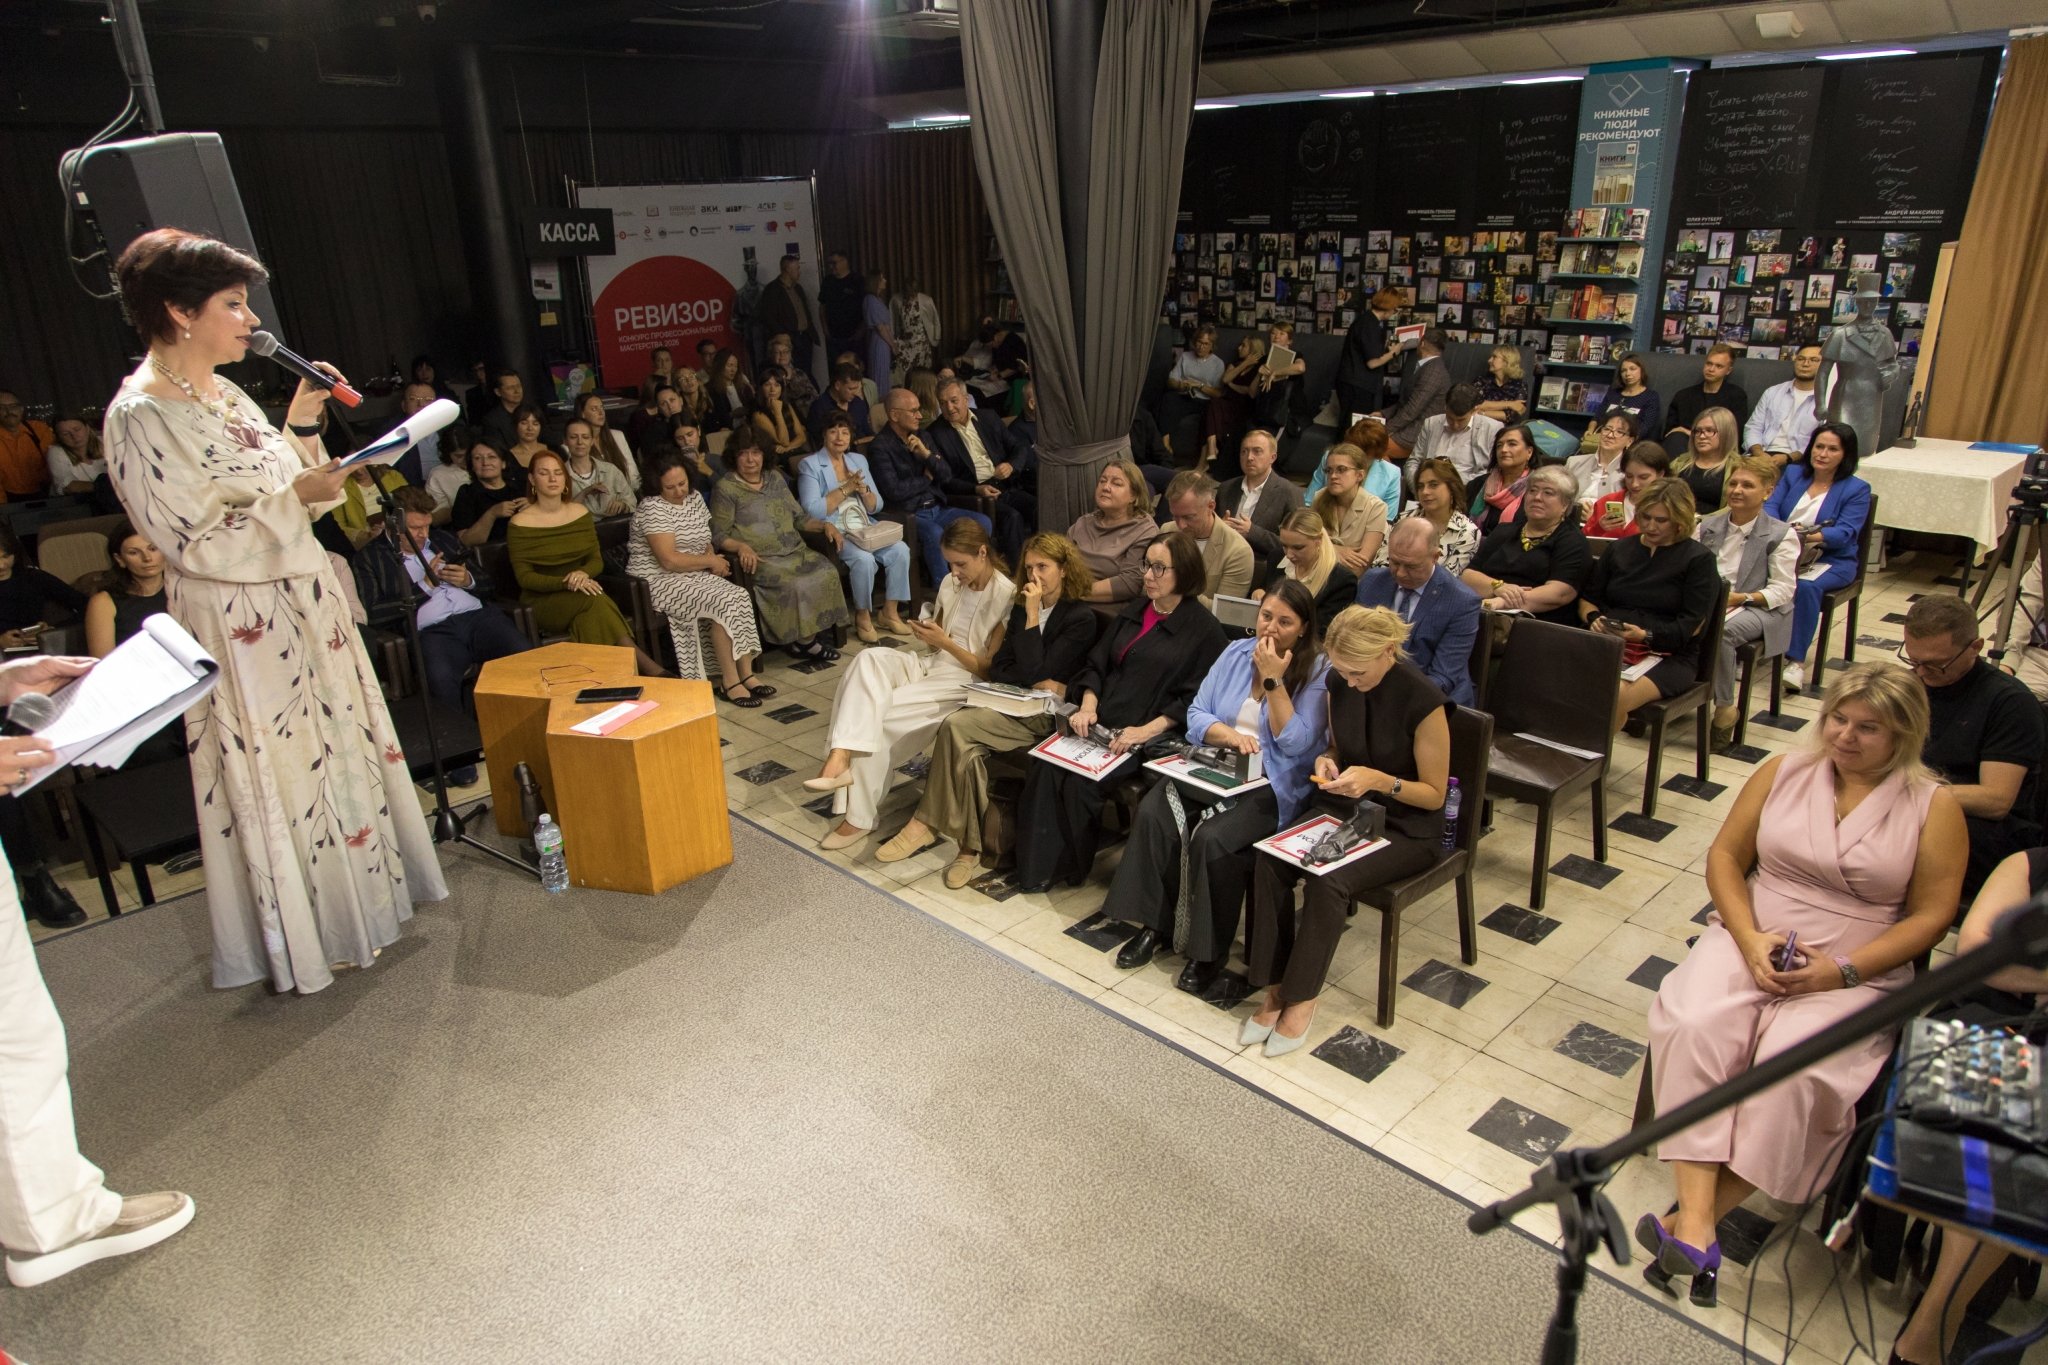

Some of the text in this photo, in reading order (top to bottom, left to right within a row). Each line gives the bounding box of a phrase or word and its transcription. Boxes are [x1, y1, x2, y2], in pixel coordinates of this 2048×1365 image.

[1594, 107, 1650, 120] КНИЖНЫЕ
[1603, 119, 1638, 130] ЛЮДИ
[1579, 128, 1661, 142] РЕКОМЕНДУЮТ
[1599, 155, 1626, 163] КНИГИ
[539, 222, 601, 242] КАССА
[614, 298, 724, 332] РЕВИЗОР
[618, 324, 724, 343] КОНКУРС ПРОФЕССИОНАЛЬНОГО
[619, 341, 663, 352] МАСТЕРСТВА
